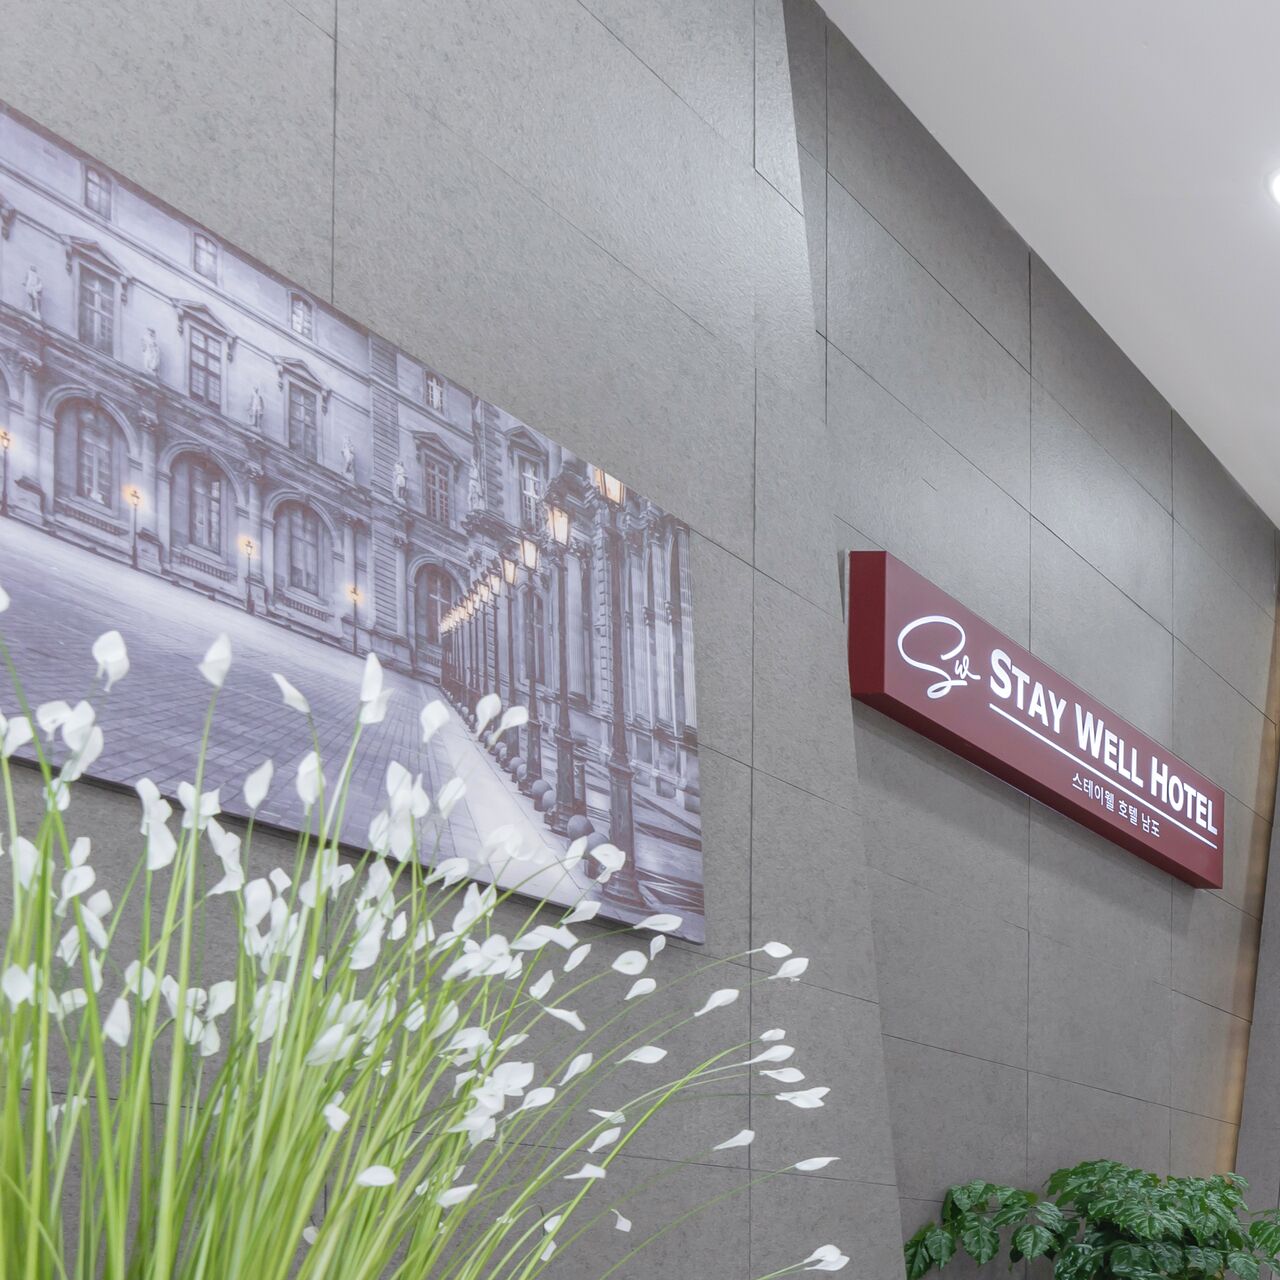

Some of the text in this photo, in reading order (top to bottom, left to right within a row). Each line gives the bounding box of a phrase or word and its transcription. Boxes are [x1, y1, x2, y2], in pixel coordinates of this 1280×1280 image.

[989, 648, 1067, 734] STAY
[1074, 703, 1144, 788] WELL
[1150, 756, 1218, 836] HOTEL
[1072, 773, 1160, 838] 스테이웰 호텔 남포
